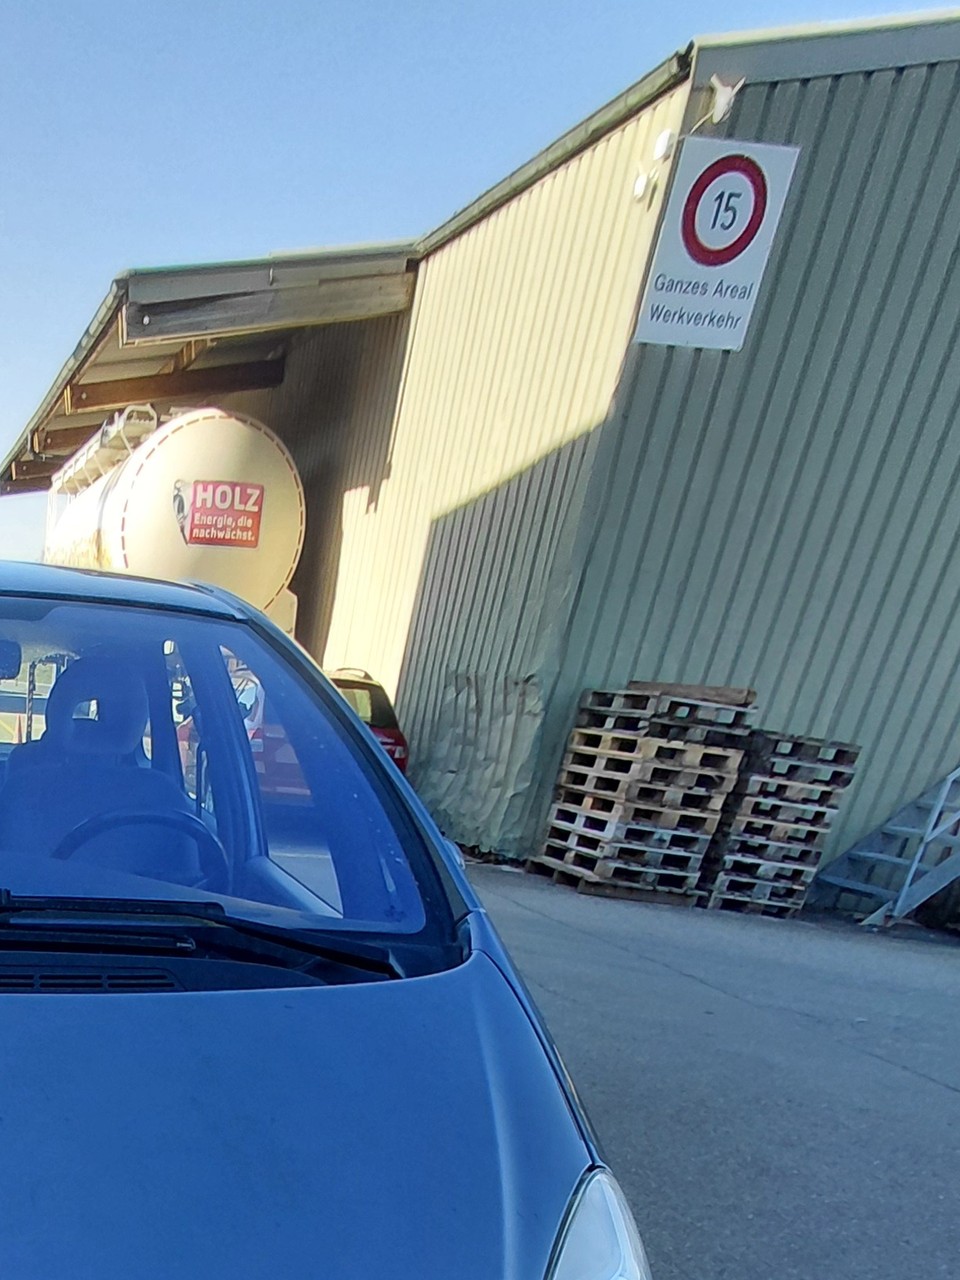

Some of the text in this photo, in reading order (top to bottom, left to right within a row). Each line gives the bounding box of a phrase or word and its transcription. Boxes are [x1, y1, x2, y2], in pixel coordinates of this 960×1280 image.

[710, 190, 743, 231] 15
[653, 272, 754, 300] Ganzes Areal
[649, 303, 742, 331] Werkverkehr
[195, 484, 260, 512] HOLZ
[192, 526, 255, 541] nachwächst.
[194, 512, 253, 528] Energie, die
